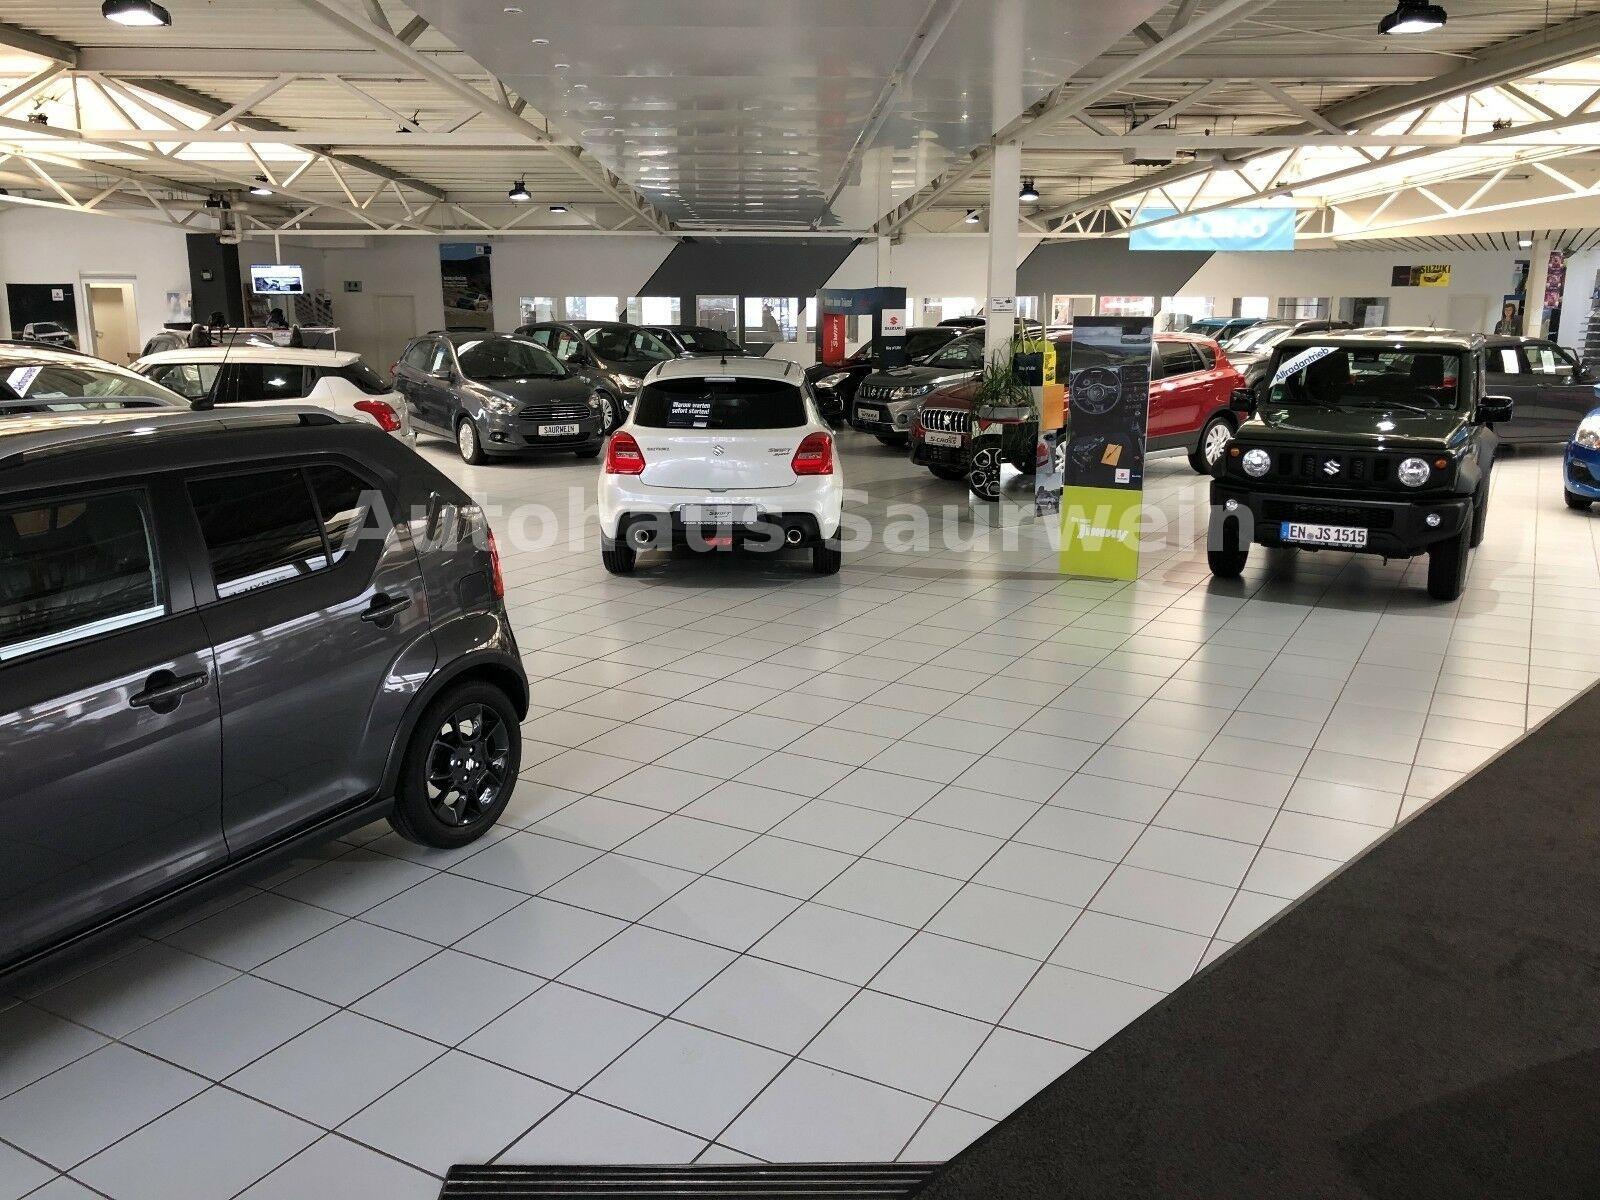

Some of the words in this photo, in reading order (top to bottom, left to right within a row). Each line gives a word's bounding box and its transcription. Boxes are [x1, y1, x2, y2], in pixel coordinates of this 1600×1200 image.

[1420, 264, 1451, 274] SUZUKI
[1275, 347, 1329, 382] Allradantrieb
[543, 425, 575, 434] SAURWEIN
[1289, 525, 1306, 539] EN
[1315, 527, 1331, 541] JS
[1333, 528, 1366, 544] 1515
